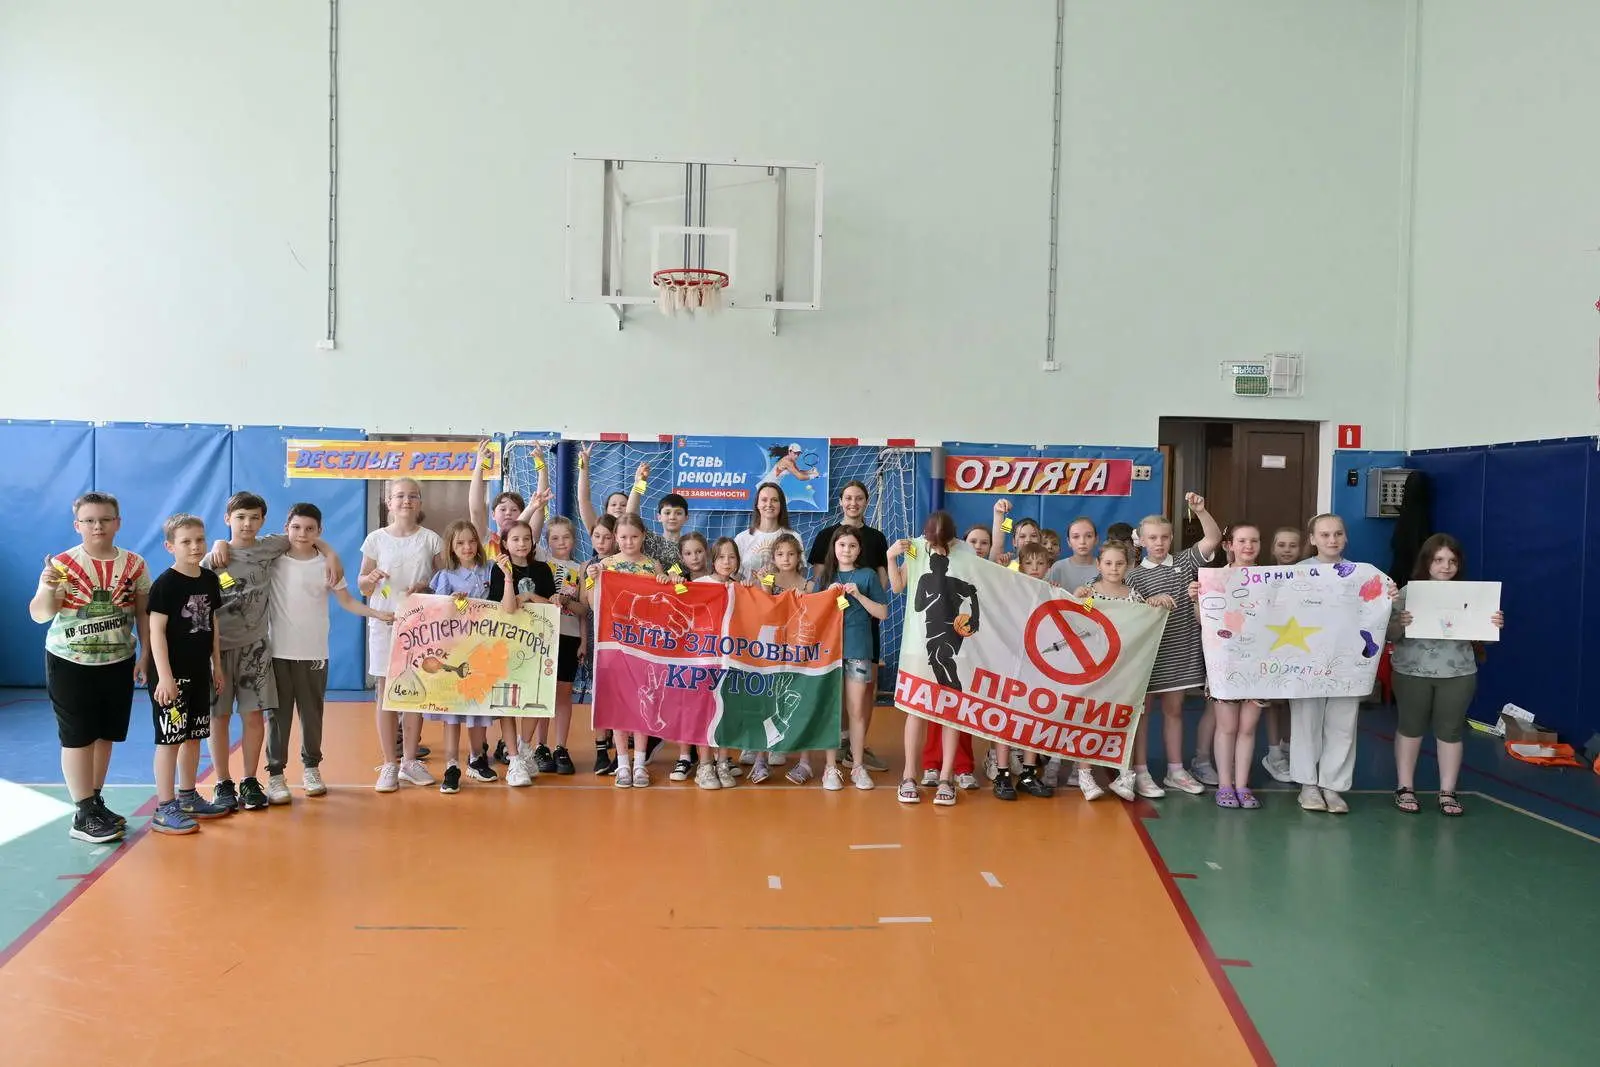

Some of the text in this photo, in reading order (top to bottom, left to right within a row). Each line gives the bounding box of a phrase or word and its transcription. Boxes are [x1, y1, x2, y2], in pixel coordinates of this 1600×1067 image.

[295, 449, 495, 471] ВЕСЕЛЫЕ РЕБЯТ
[678, 452, 723, 468] Ставь
[677, 471, 747, 488] рекорды
[955, 459, 1111, 493] ОРЛЯТА
[691, 490, 746, 498] ЗАВИСИМОСТИ
[611, 622, 677, 649] БЫТЬ
[665, 663, 775, 697] КРУТО!
[969, 667, 1134, 729] ПРОТИВ
[896, 672, 1122, 758] НАРКОТИКОВ
